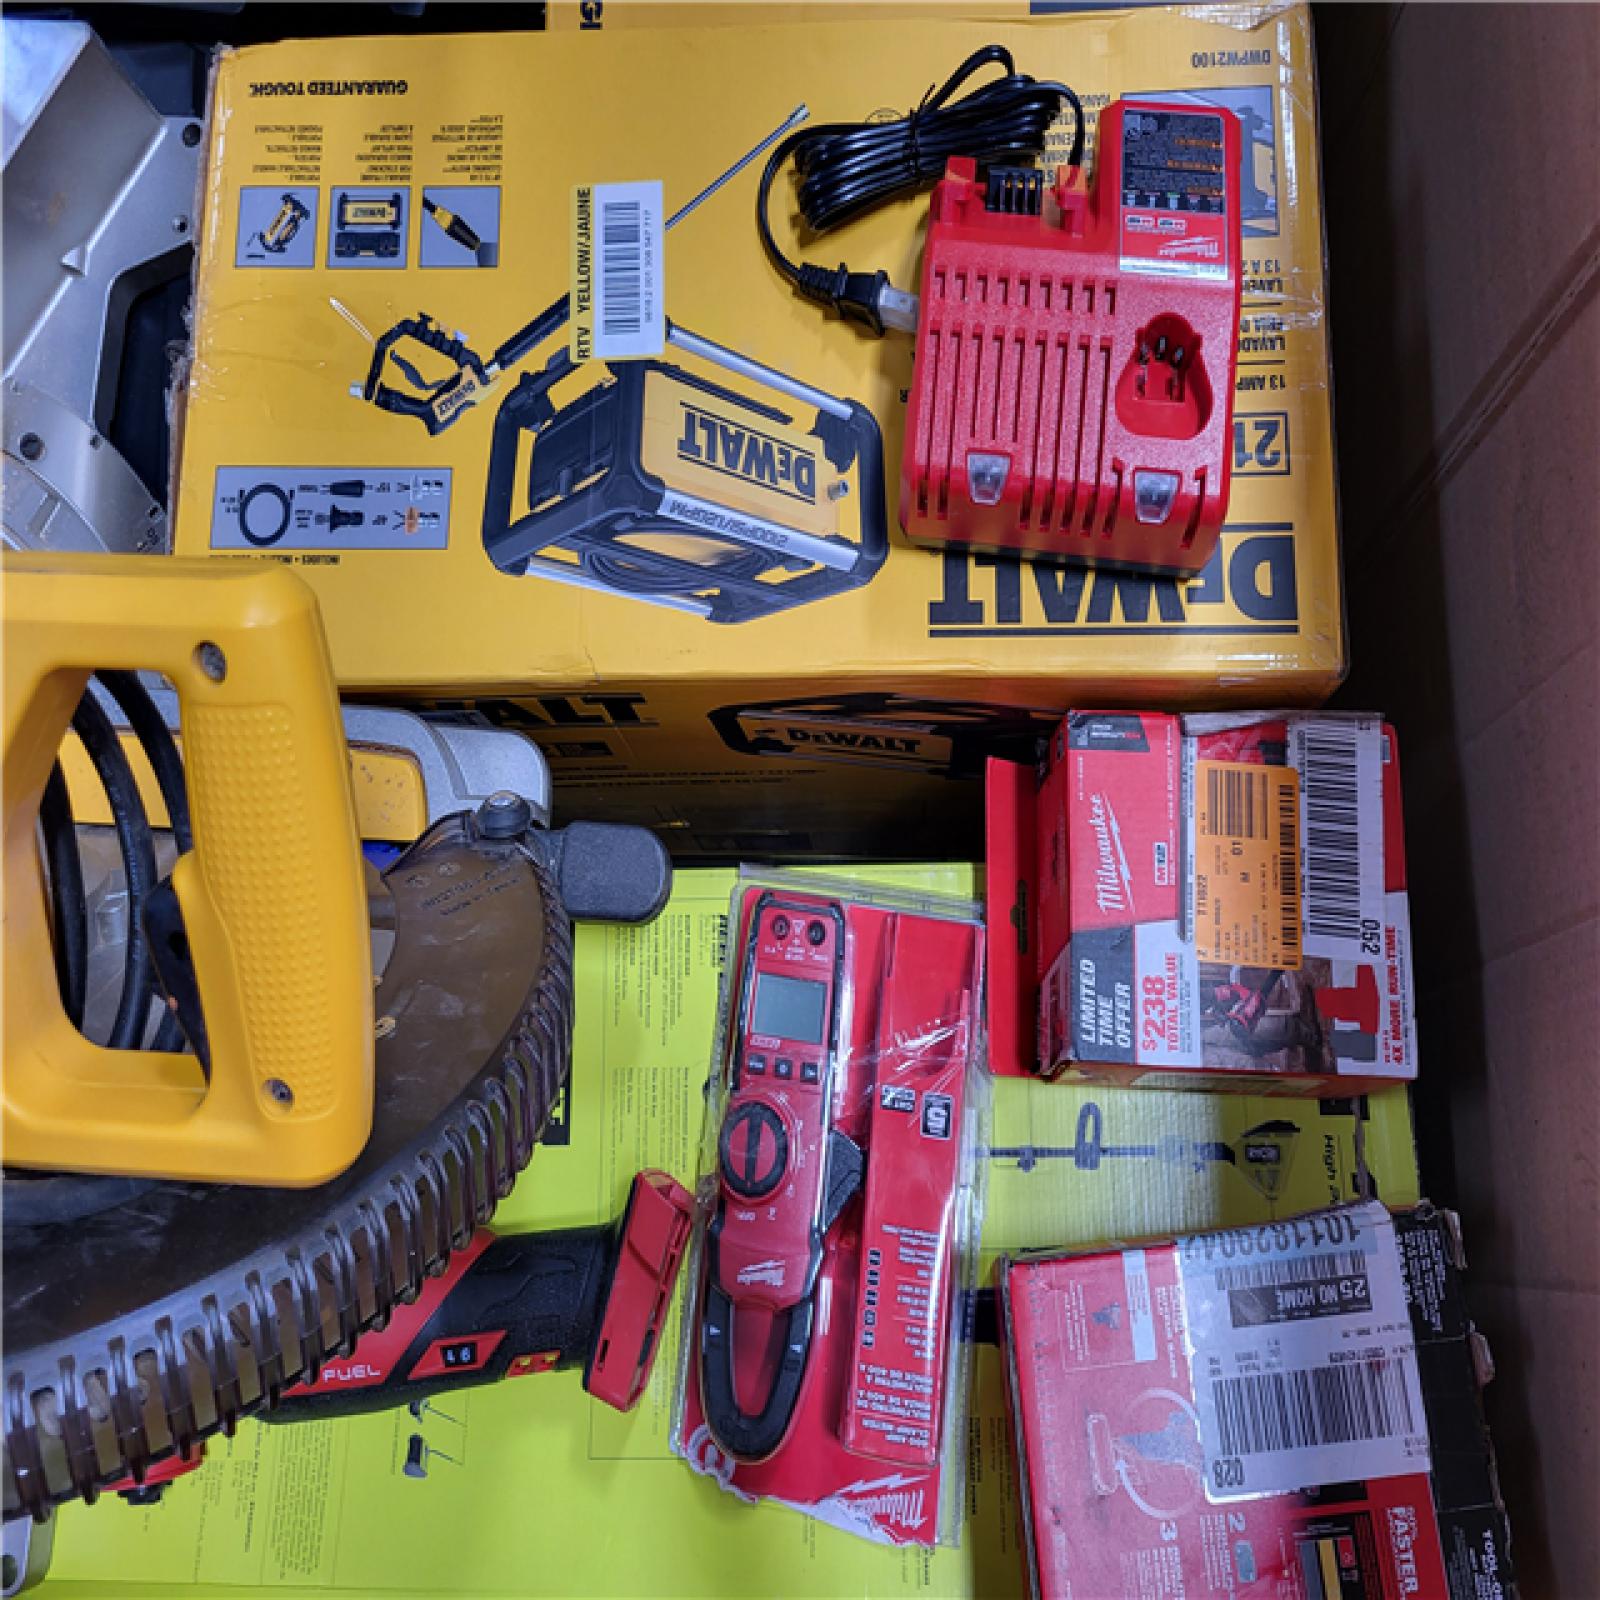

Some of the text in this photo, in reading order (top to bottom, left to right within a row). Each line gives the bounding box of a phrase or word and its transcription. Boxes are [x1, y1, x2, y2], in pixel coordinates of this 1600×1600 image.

[1192, 50, 1272, 67] DWPW2100
[306, 80, 408, 96] GUARANTEED
[577, 187, 590, 359] RTV YELLOW/JAUNE
[1269, 375, 1286, 391] 13
[677, 411, 816, 498] DEWALT
[928, 535, 1299, 626] DEWALT
[787, 727, 920, 753] DEWALT
[1087, 791, 1126, 916] Milwaukee
[1360, 920, 1381, 956] 052
[1384, 925, 1400, 996] RUN-TIME
[1080, 959, 1096, 1044] LIMITED
[1097, 994, 1113, 1046] TIME
[1115, 981, 1131, 1049] OFFER
[1142, 975, 1166, 1051] $238
[1165, 951, 1179, 1052] TOTAL VALUE
[1389, 999, 1402, 1042] MORE
[1274, 1288, 1316, 1311] HOME
[1340, 1279, 1366, 1298] 25
[322, 1364, 381, 1383] FUEL
[1212, 1458, 1246, 1489] 028
